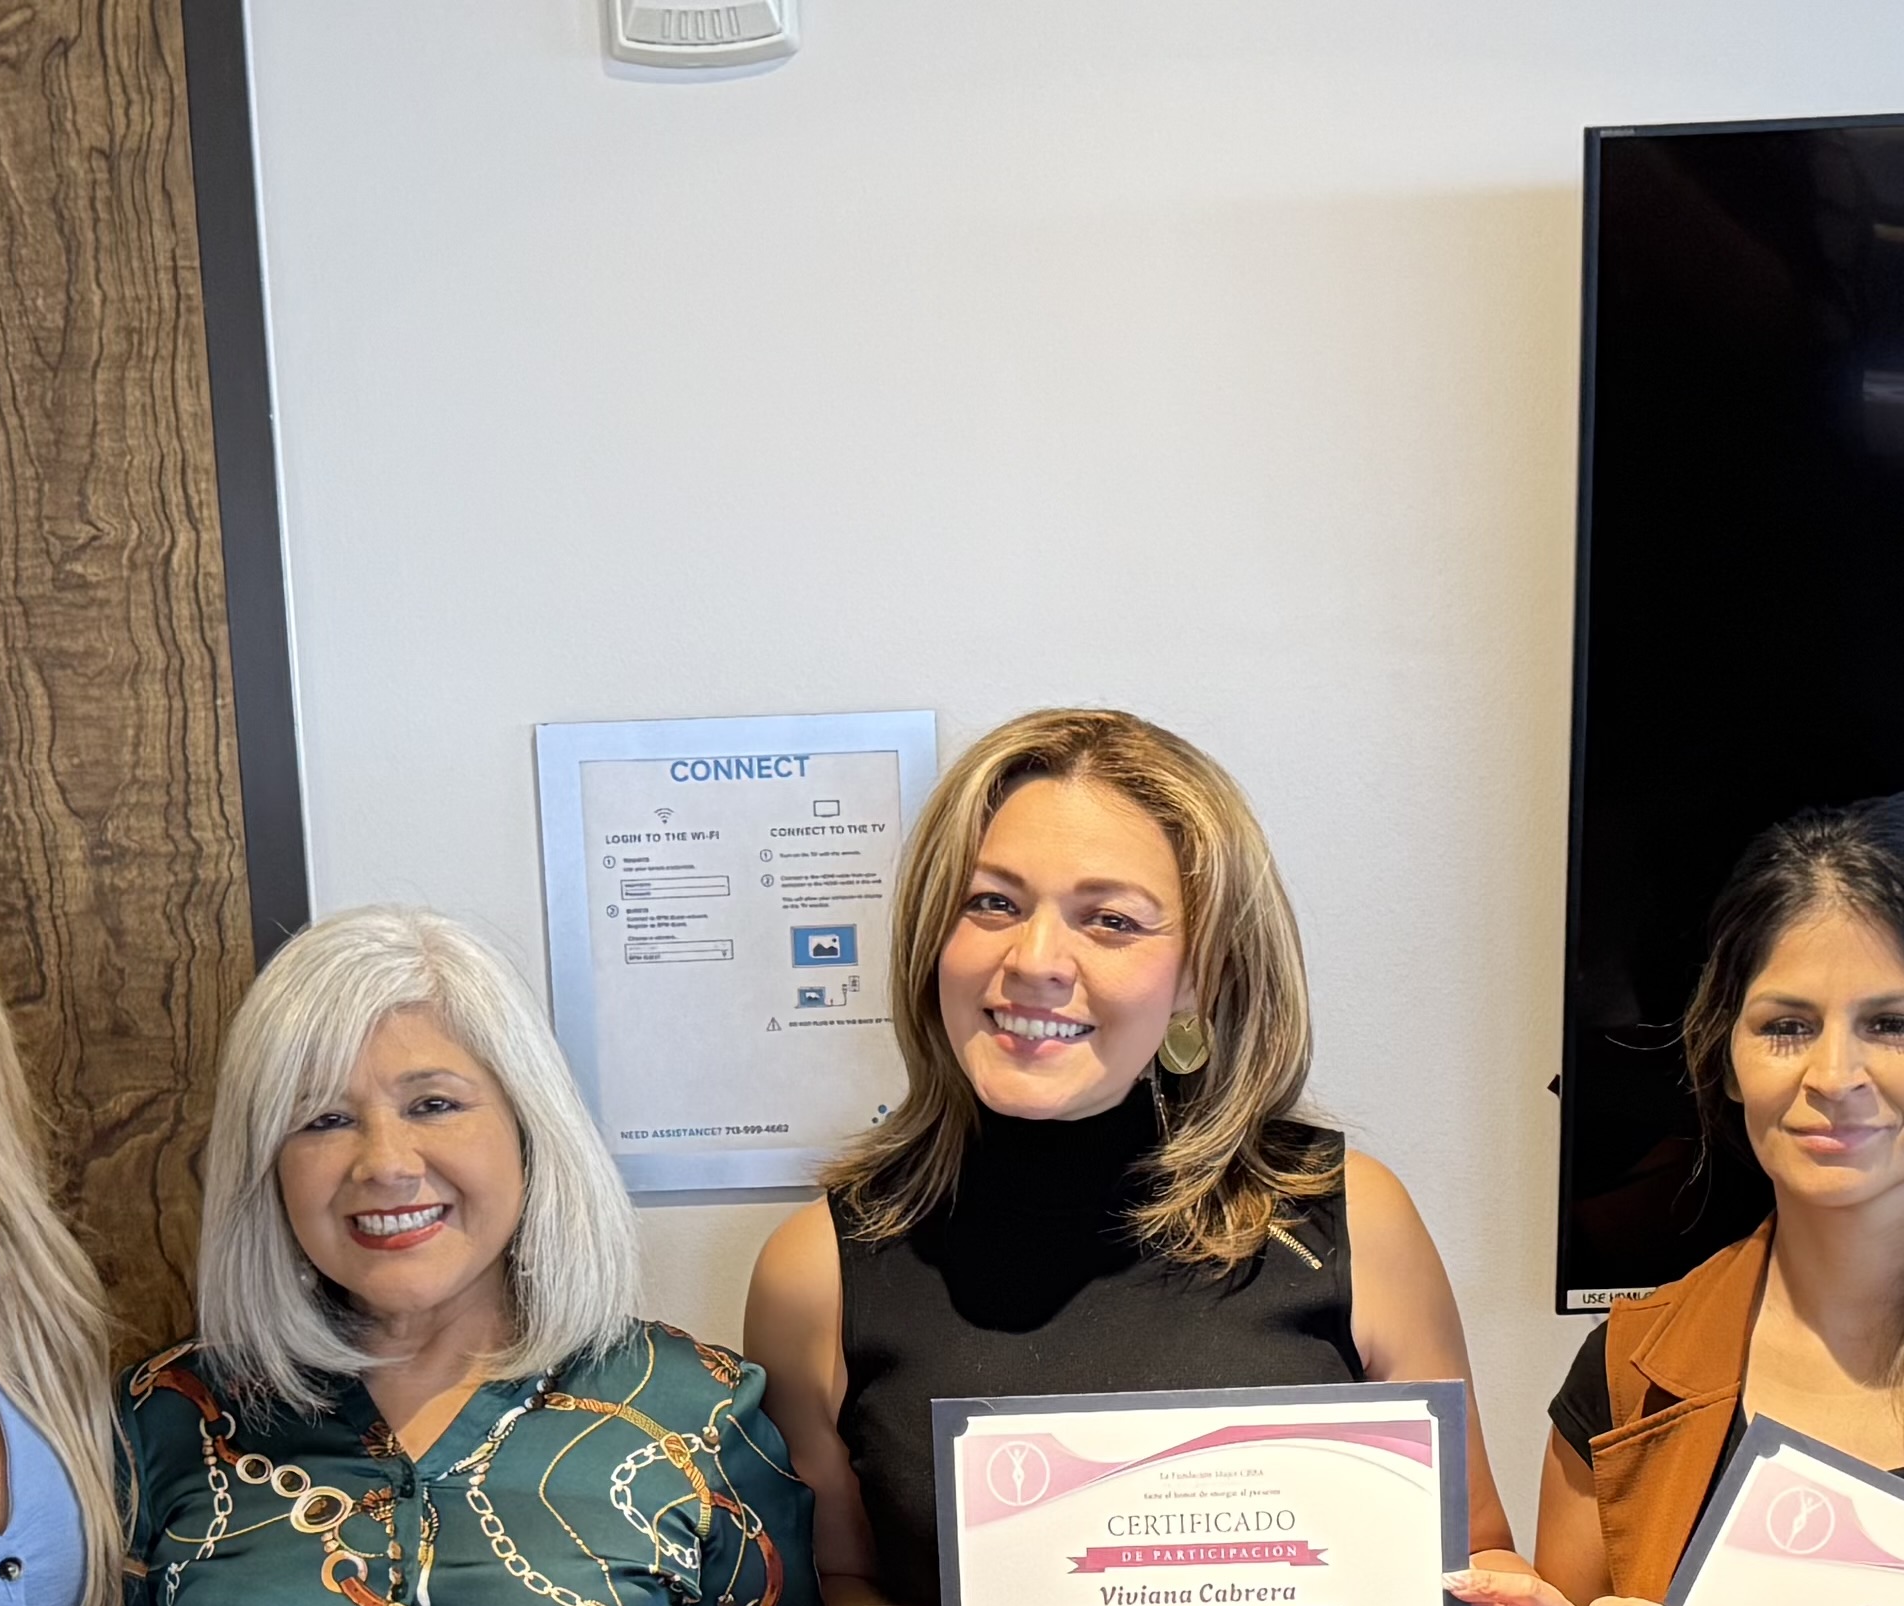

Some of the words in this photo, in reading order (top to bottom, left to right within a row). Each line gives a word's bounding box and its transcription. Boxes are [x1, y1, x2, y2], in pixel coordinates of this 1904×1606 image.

[670, 755, 810, 783] CONNECT
[770, 825, 826, 837] CONNECT
[829, 825, 845, 835] TO
[847, 824, 868, 834] THE
[871, 823, 886, 833] TV
[605, 833, 642, 845] LOGIN
[645, 833, 661, 843] TO
[664, 832, 688, 842] THE
[620, 1130, 649, 1140] NEED
[1582, 1292, 1606, 1304] USE
[1106, 1508, 1296, 1537] CERTIFICADO
[1121, 1550, 1143, 1562] DE
[1099, 1583, 1192, 1606] Viviana
[1198, 1580, 1296, 1603] Cabrera
